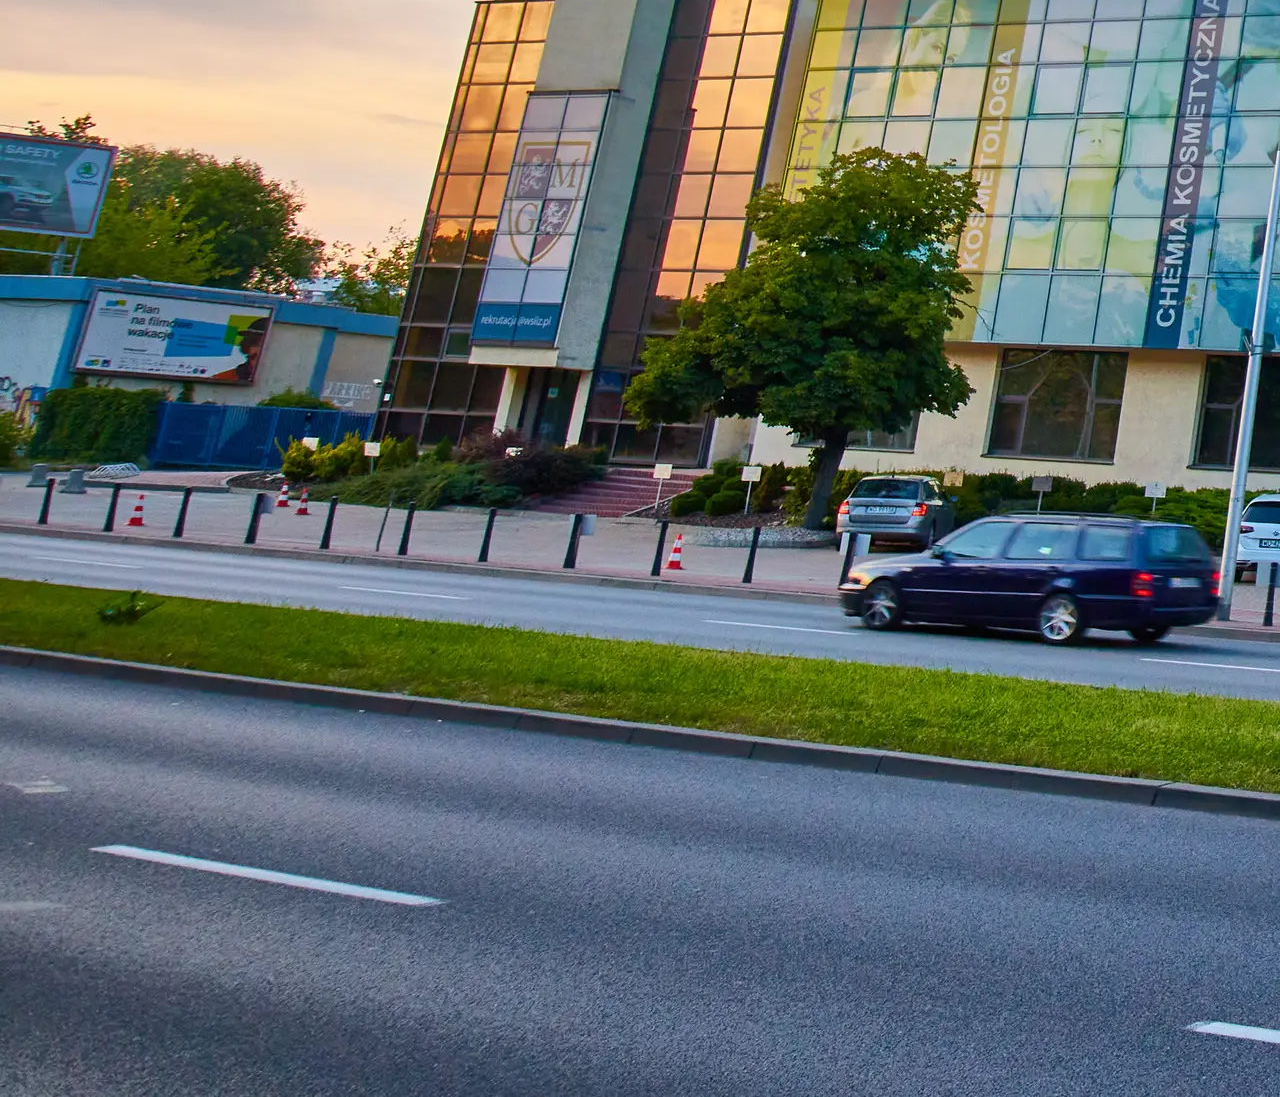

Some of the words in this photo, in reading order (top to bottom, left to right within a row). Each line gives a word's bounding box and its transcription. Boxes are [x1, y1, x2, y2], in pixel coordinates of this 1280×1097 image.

[962, 48, 1015, 269] KOSMETOLOGIA
[1156, 213, 1189, 328] CHEMIA
[134, 304, 160, 315] Plan
[131, 316, 145, 326] na
[148, 317, 194, 330] filmowe
[127, 328, 174, 342] wakacje
